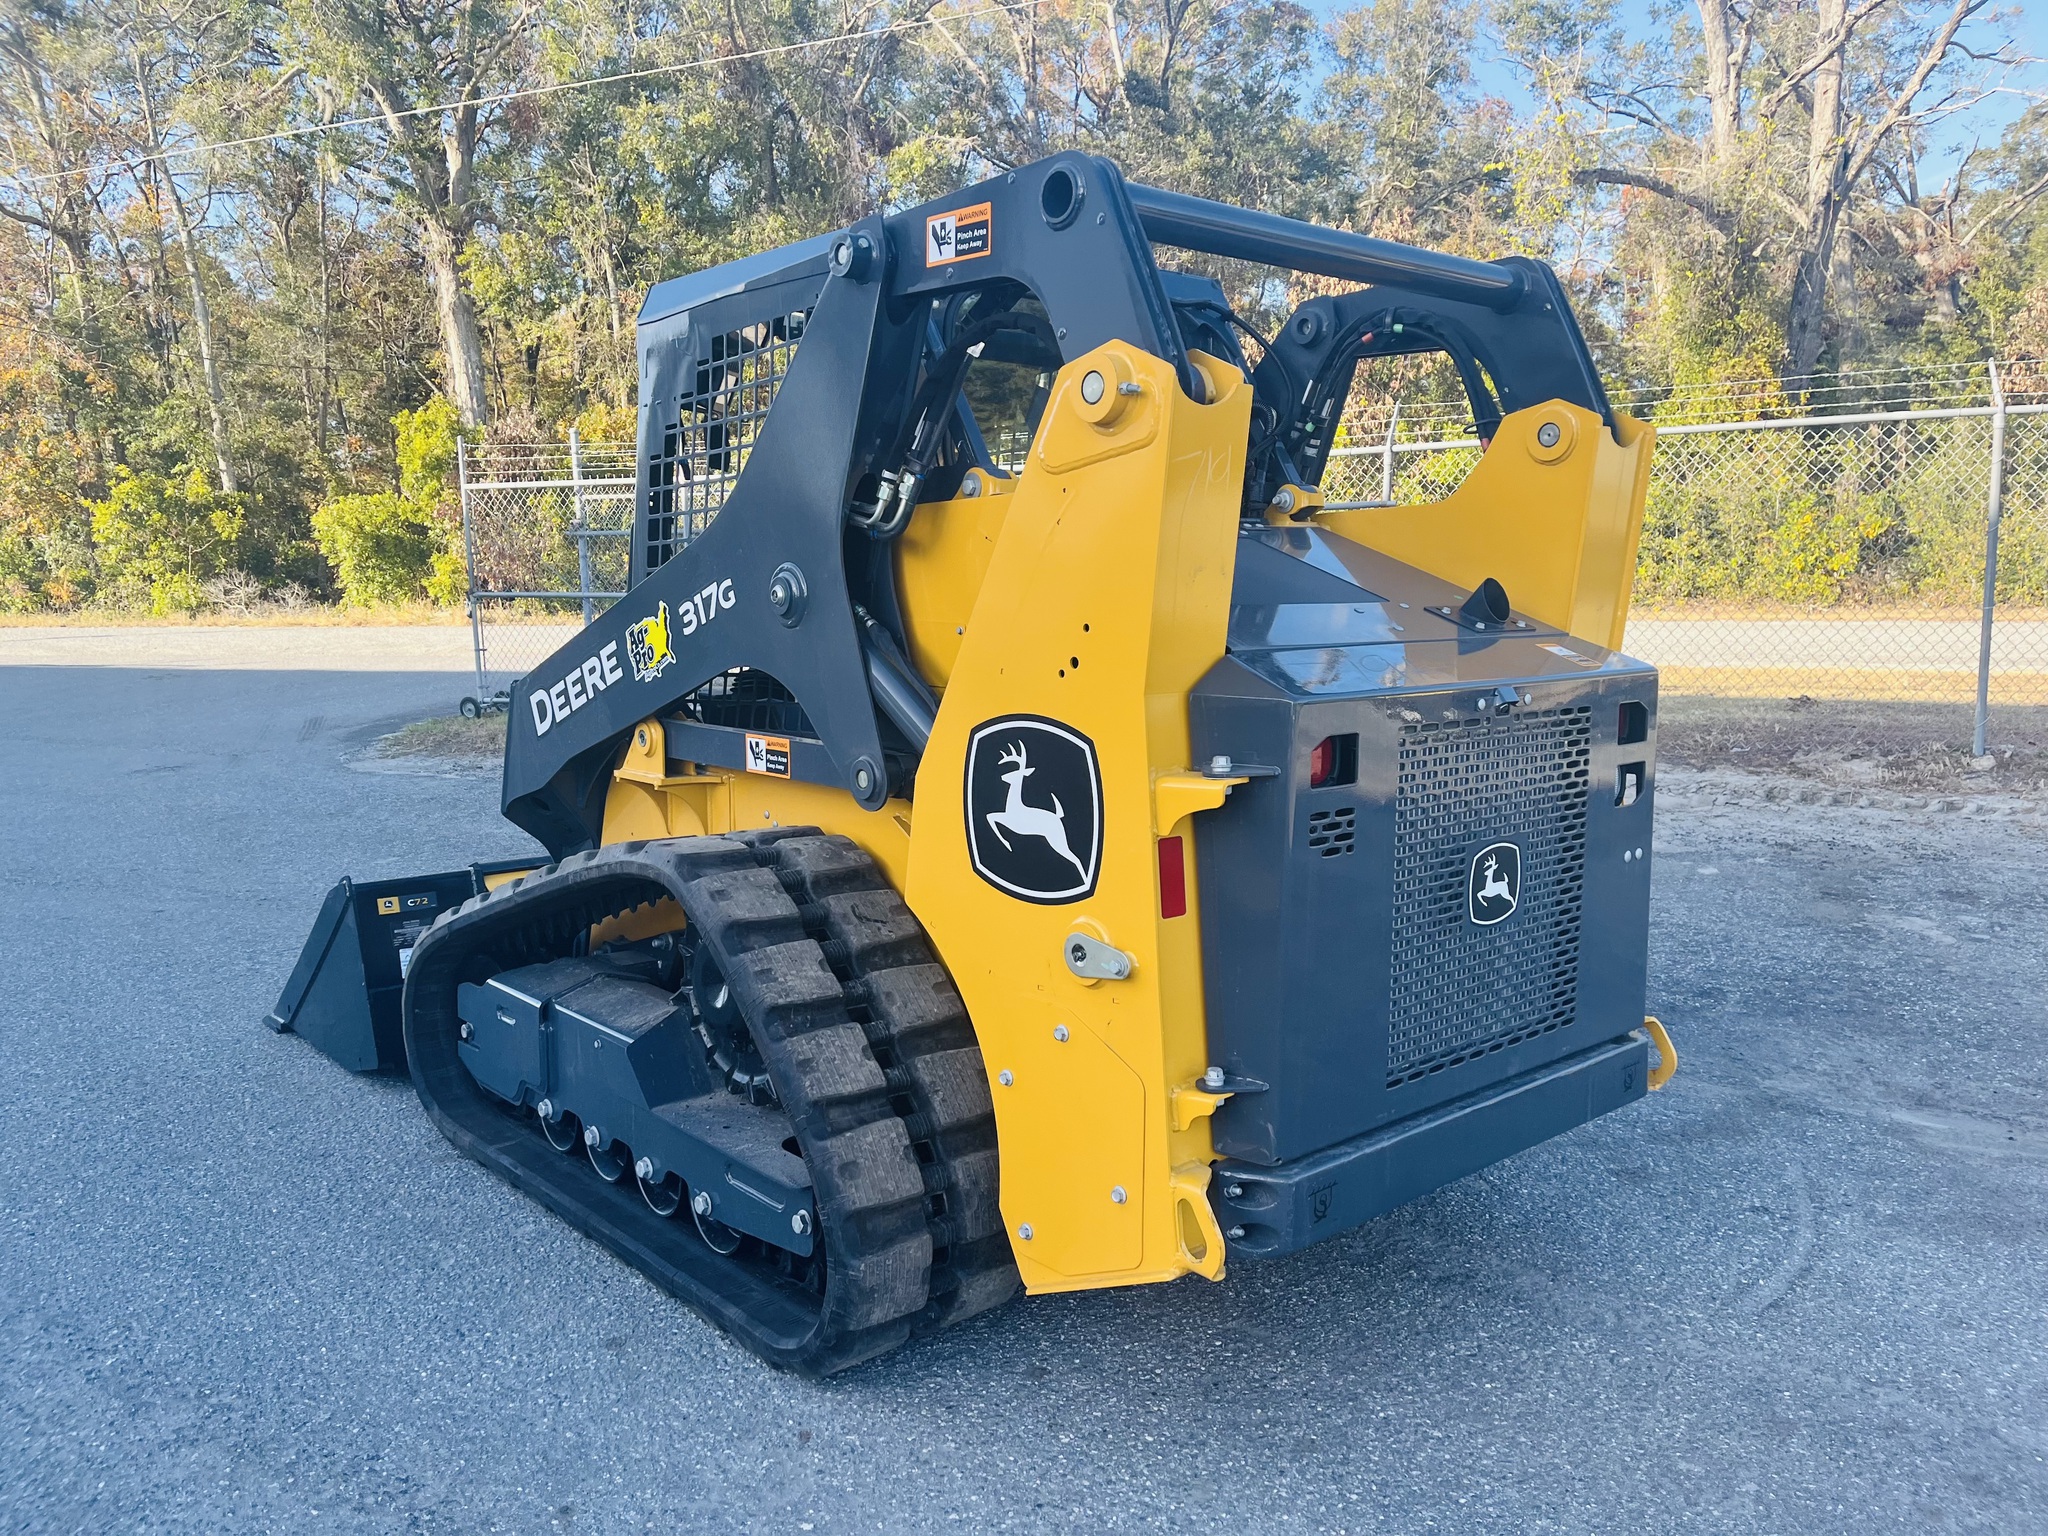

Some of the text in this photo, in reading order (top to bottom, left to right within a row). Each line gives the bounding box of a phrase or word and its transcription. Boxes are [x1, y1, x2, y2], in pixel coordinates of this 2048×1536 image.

[963, 208, 988, 220] WARNING
[957, 228, 986, 240] Pinch Area
[970, 240, 982, 248] Away
[678, 578, 736, 636] 317G
[632, 645, 655, 675] Pro
[529, 640, 624, 737] DEERE
[407, 897, 428, 906] C72
